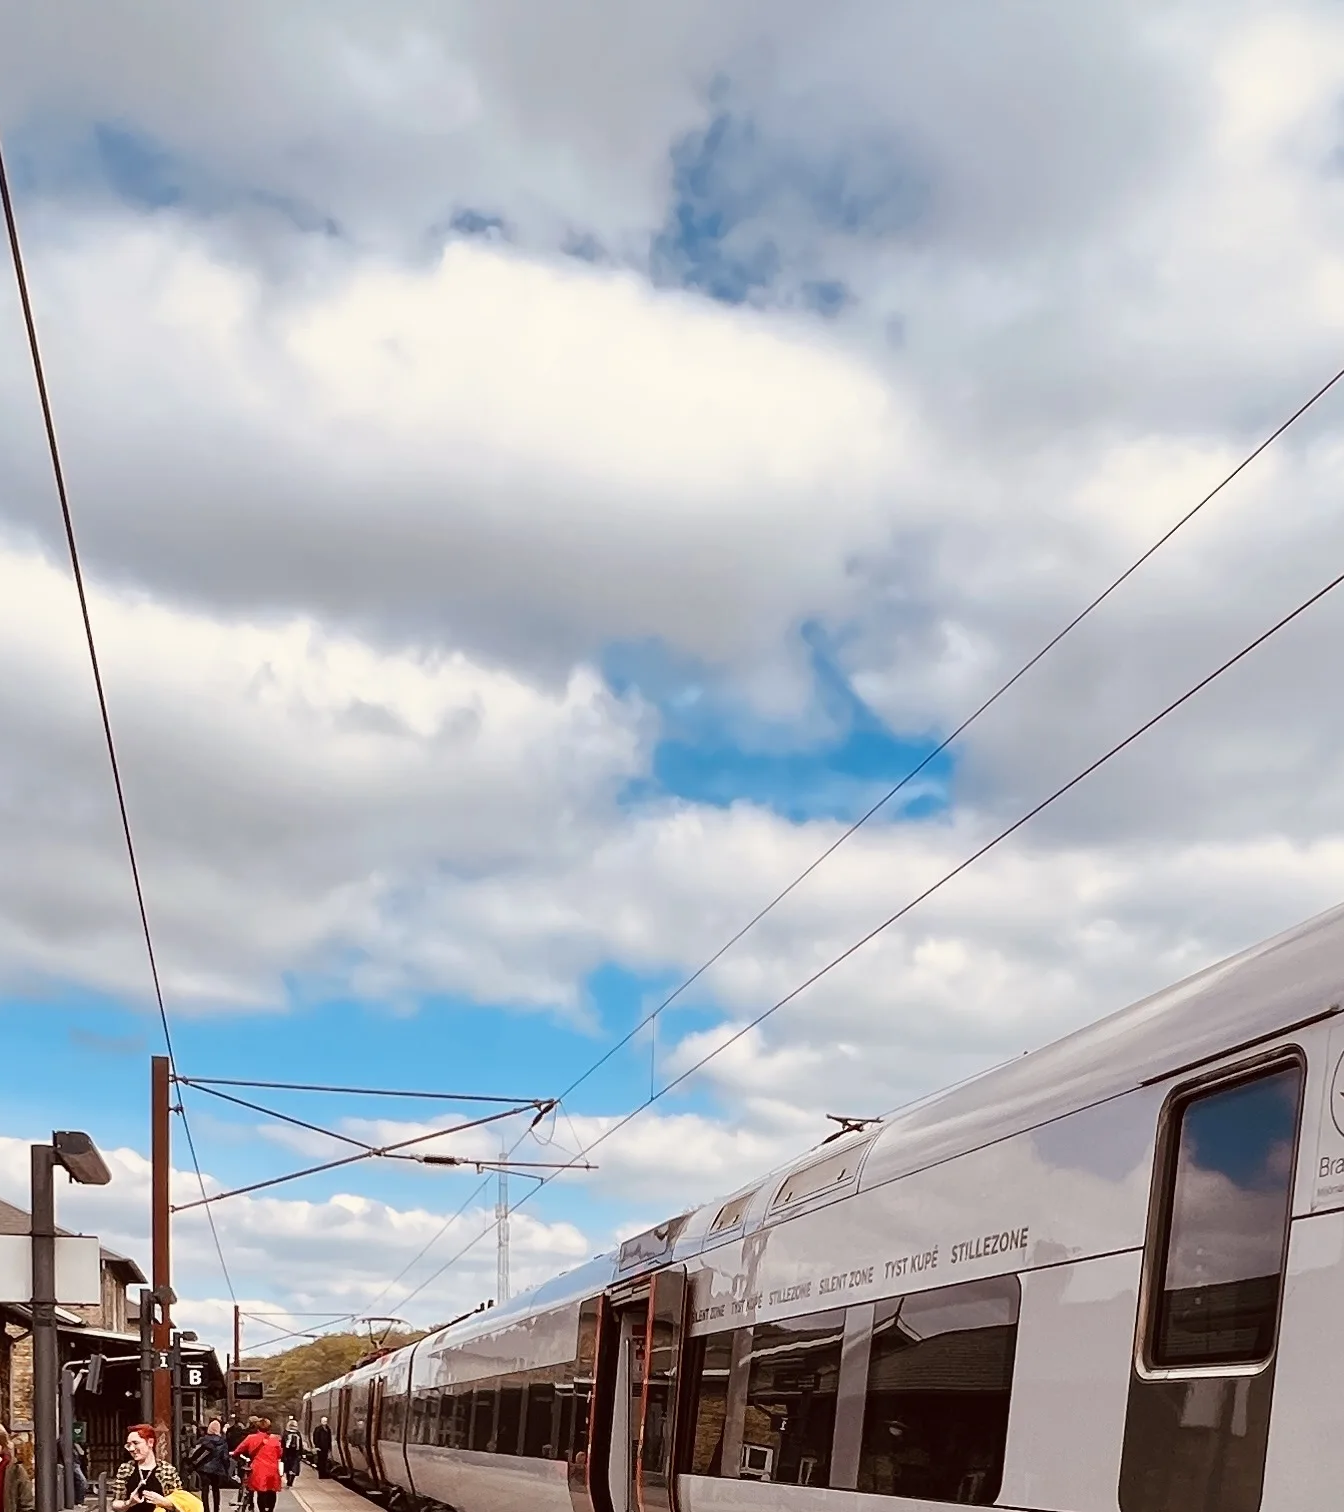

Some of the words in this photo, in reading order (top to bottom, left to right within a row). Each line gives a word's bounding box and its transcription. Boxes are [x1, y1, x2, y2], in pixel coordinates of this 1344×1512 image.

[1318, 1156, 1344, 1178] Bra
[818, 1273, 847, 1295] SILENT
[848, 1266, 874, 1289] ZONE
[884, 1257, 908, 1280] TYST
[909, 1245, 939, 1274] KUPÉ
[950, 1227, 1030, 1265] STILLEZONE
[159, 1356, 168, 1368] 1
[189, 1369, 202, 1386] B
